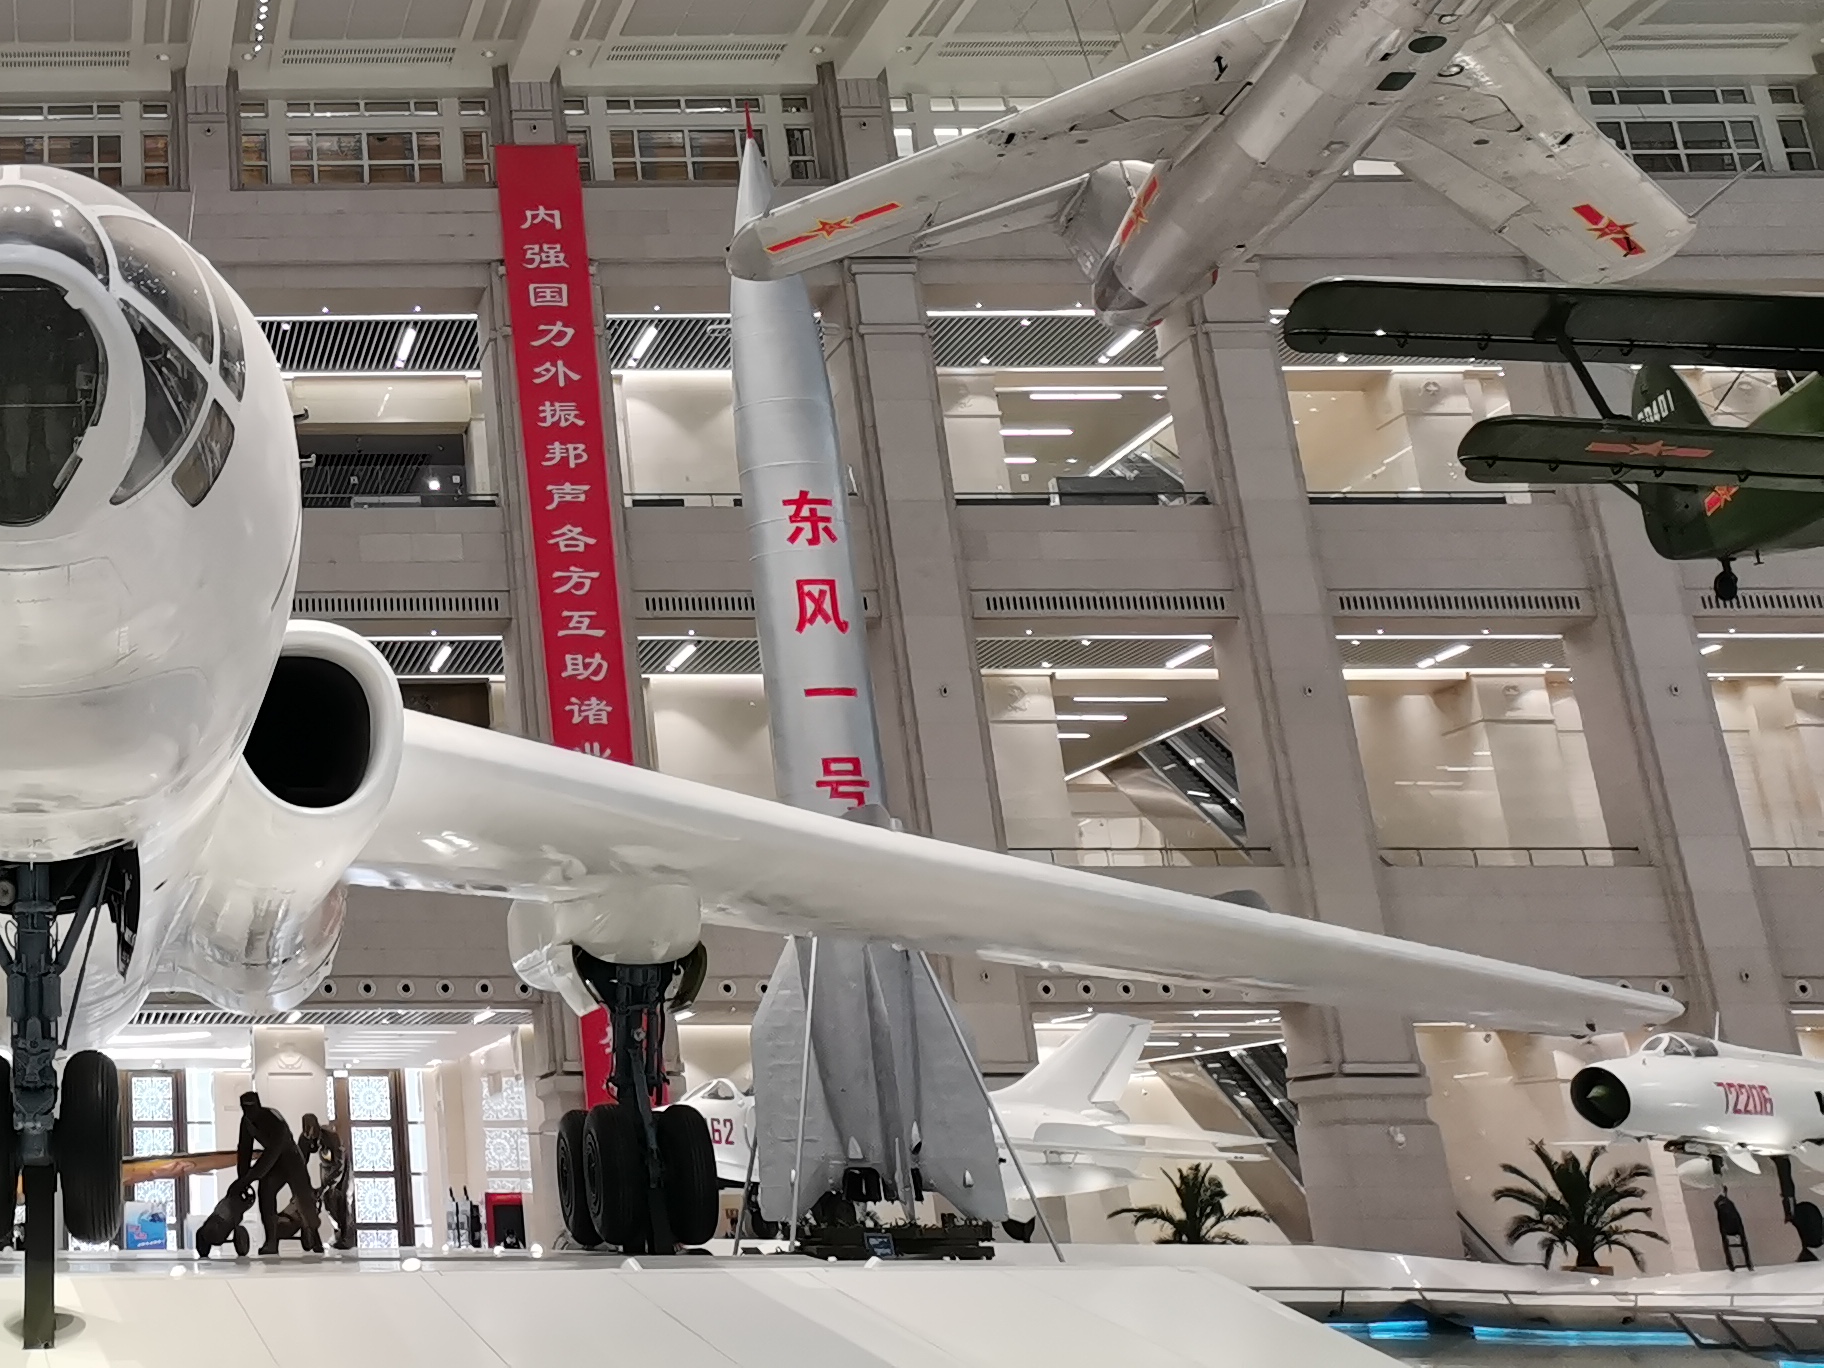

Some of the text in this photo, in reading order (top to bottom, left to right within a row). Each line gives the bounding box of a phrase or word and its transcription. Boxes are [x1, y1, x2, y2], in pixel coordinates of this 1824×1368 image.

[781, 489, 870, 811] 东风一号
[1713, 1081, 1774, 1117] 72206
[704, 1117, 735, 1145] 62
